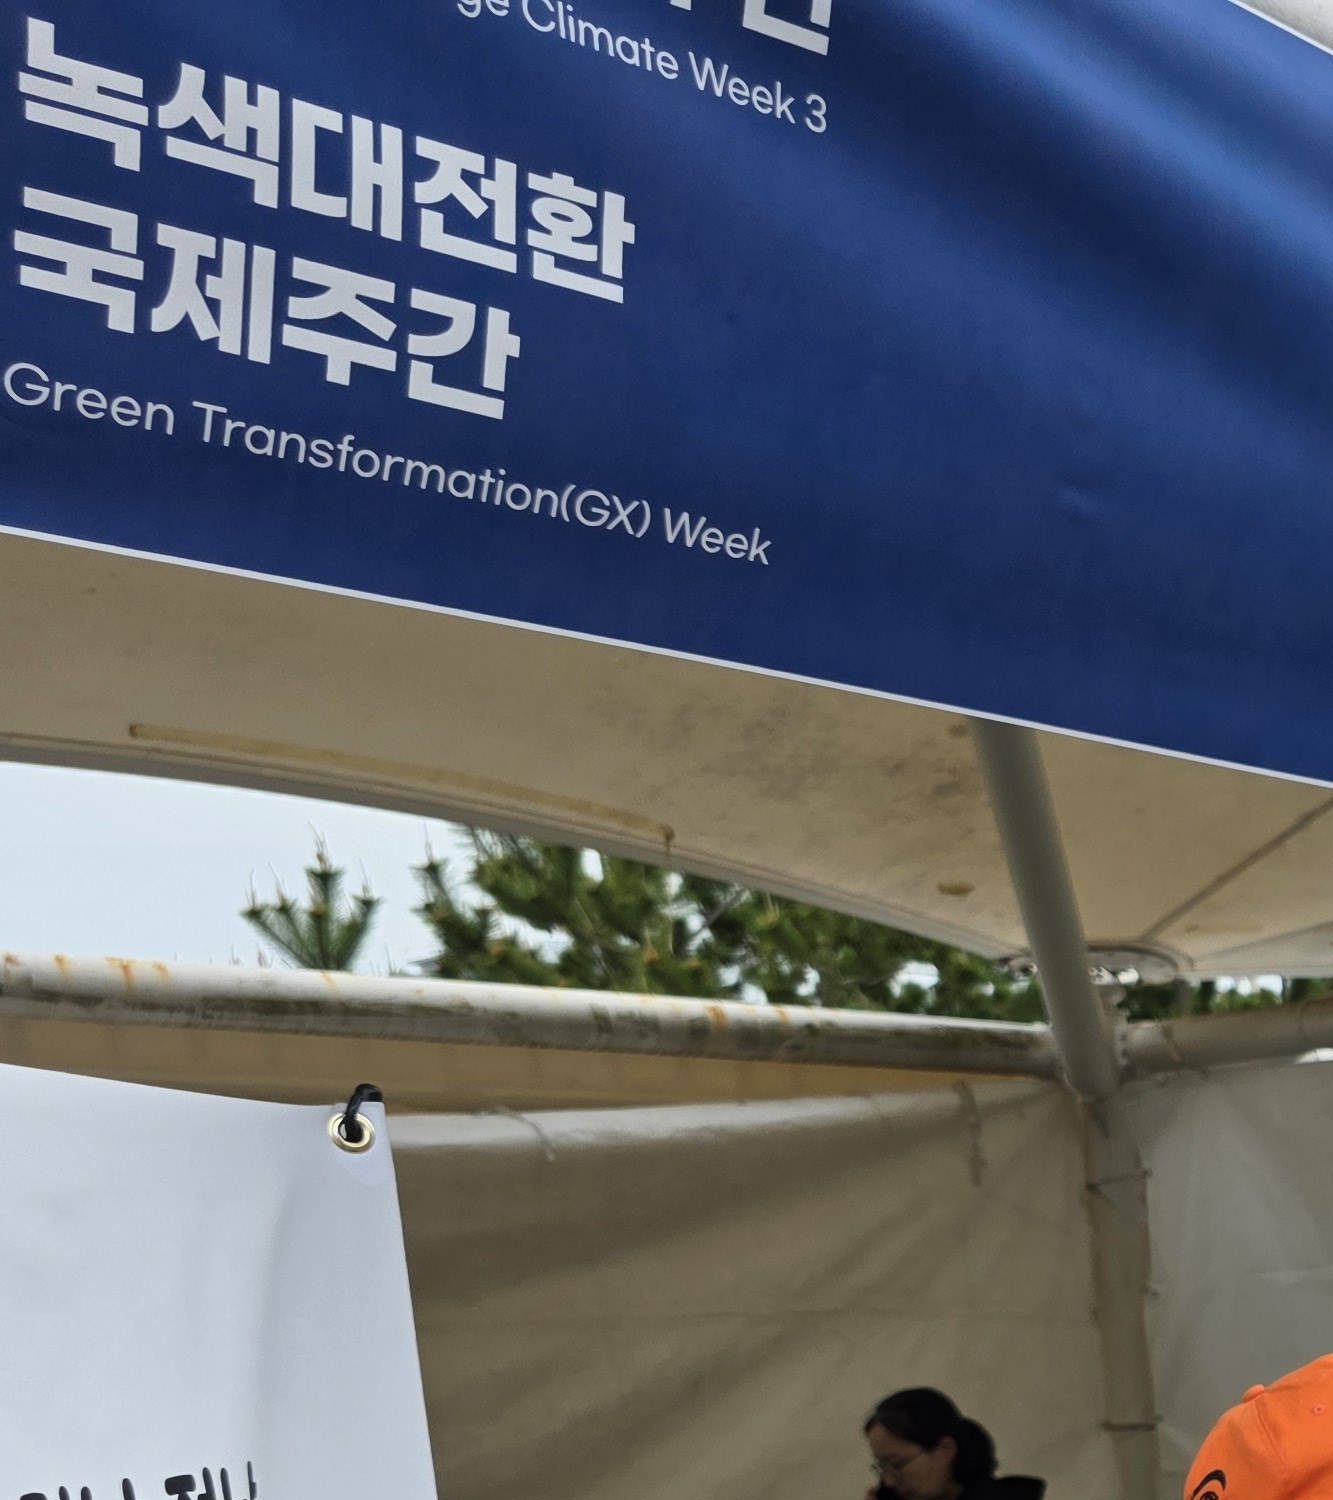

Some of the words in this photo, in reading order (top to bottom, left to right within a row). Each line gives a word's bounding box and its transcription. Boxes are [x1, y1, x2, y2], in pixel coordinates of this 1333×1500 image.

[18, 16, 635, 304] 녹색대전환
[522, 0, 679, 79] Climate
[688, 51, 796, 124] Week
[804, 94, 828, 133] 3
[12, 185, 521, 420] 국제주간
[3, 362, 174, 434] Green
[191, 399, 651, 540] Transformation(GX)
[663, 508, 772, 566] Week
